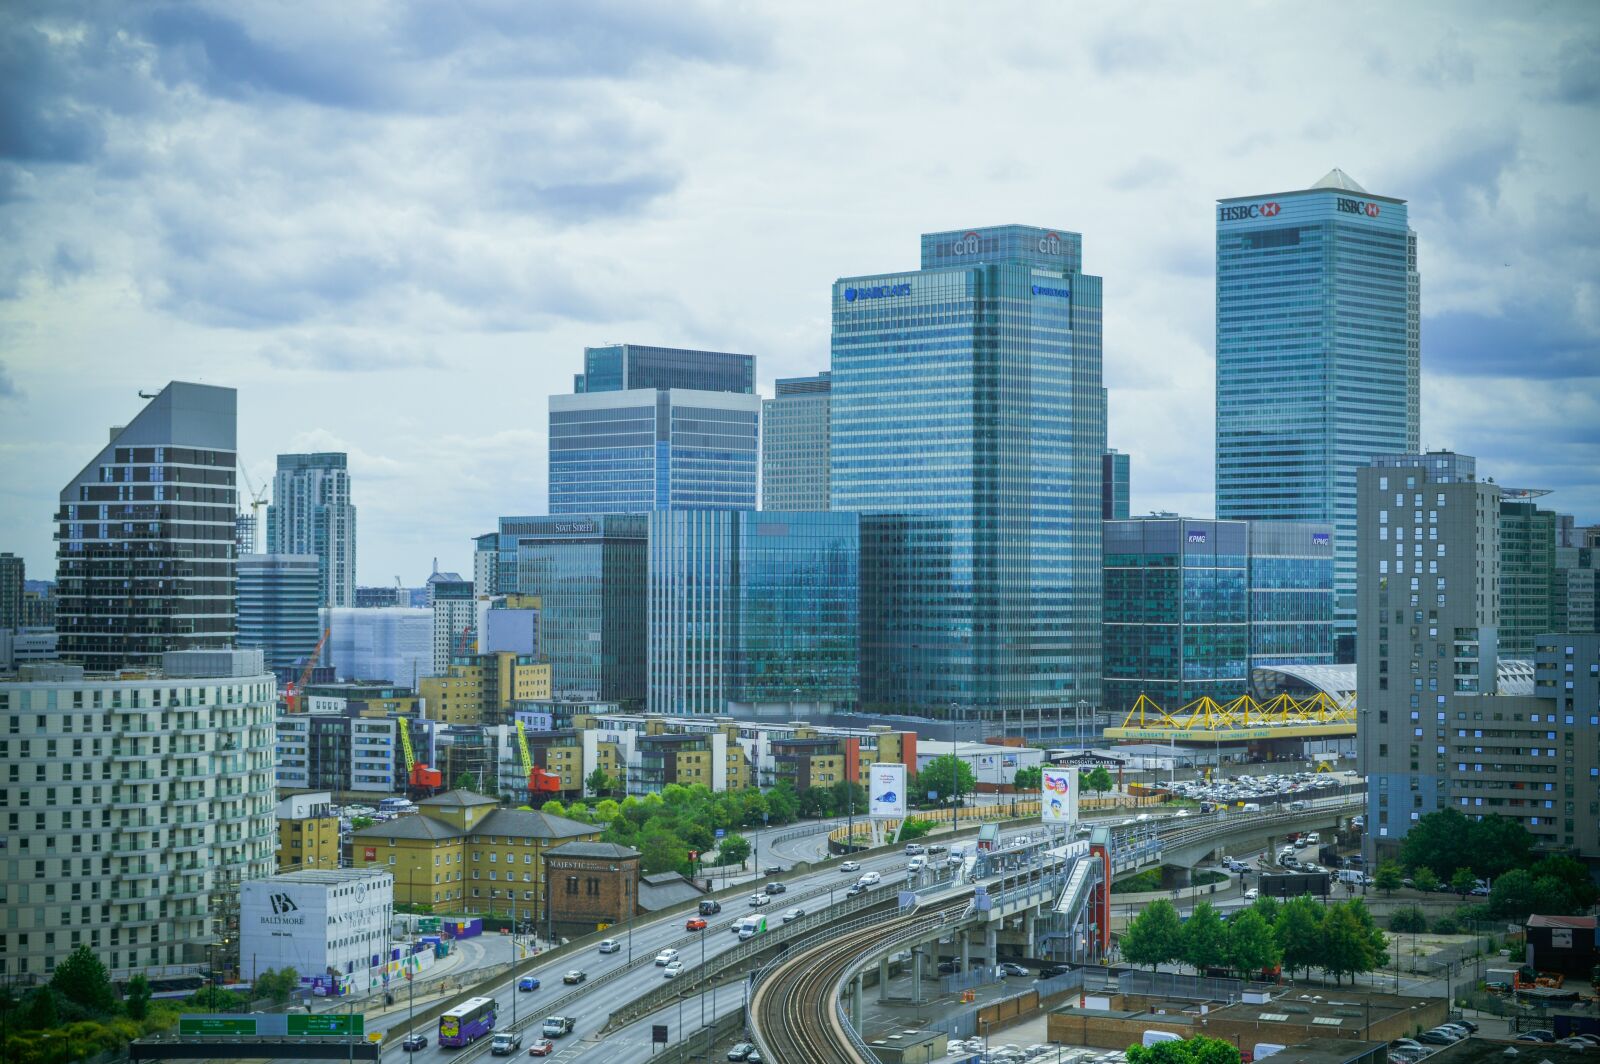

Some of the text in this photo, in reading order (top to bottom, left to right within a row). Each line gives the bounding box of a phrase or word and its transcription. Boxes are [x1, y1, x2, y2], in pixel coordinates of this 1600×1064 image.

[1220, 204, 1259, 221] HSBC
[1336, 197, 1365, 215] HSBC
[954, 236, 979, 255] citi
[1039, 237, 1060, 255] citi
[858, 283, 911, 300] BARCLAYS
[1188, 535, 1206, 543] KPMG
[1312, 538, 1328, 546] KPMG
[550, 860, 584, 869] MAJESTIC
[260, 916, 304, 925] BALLYMORE
